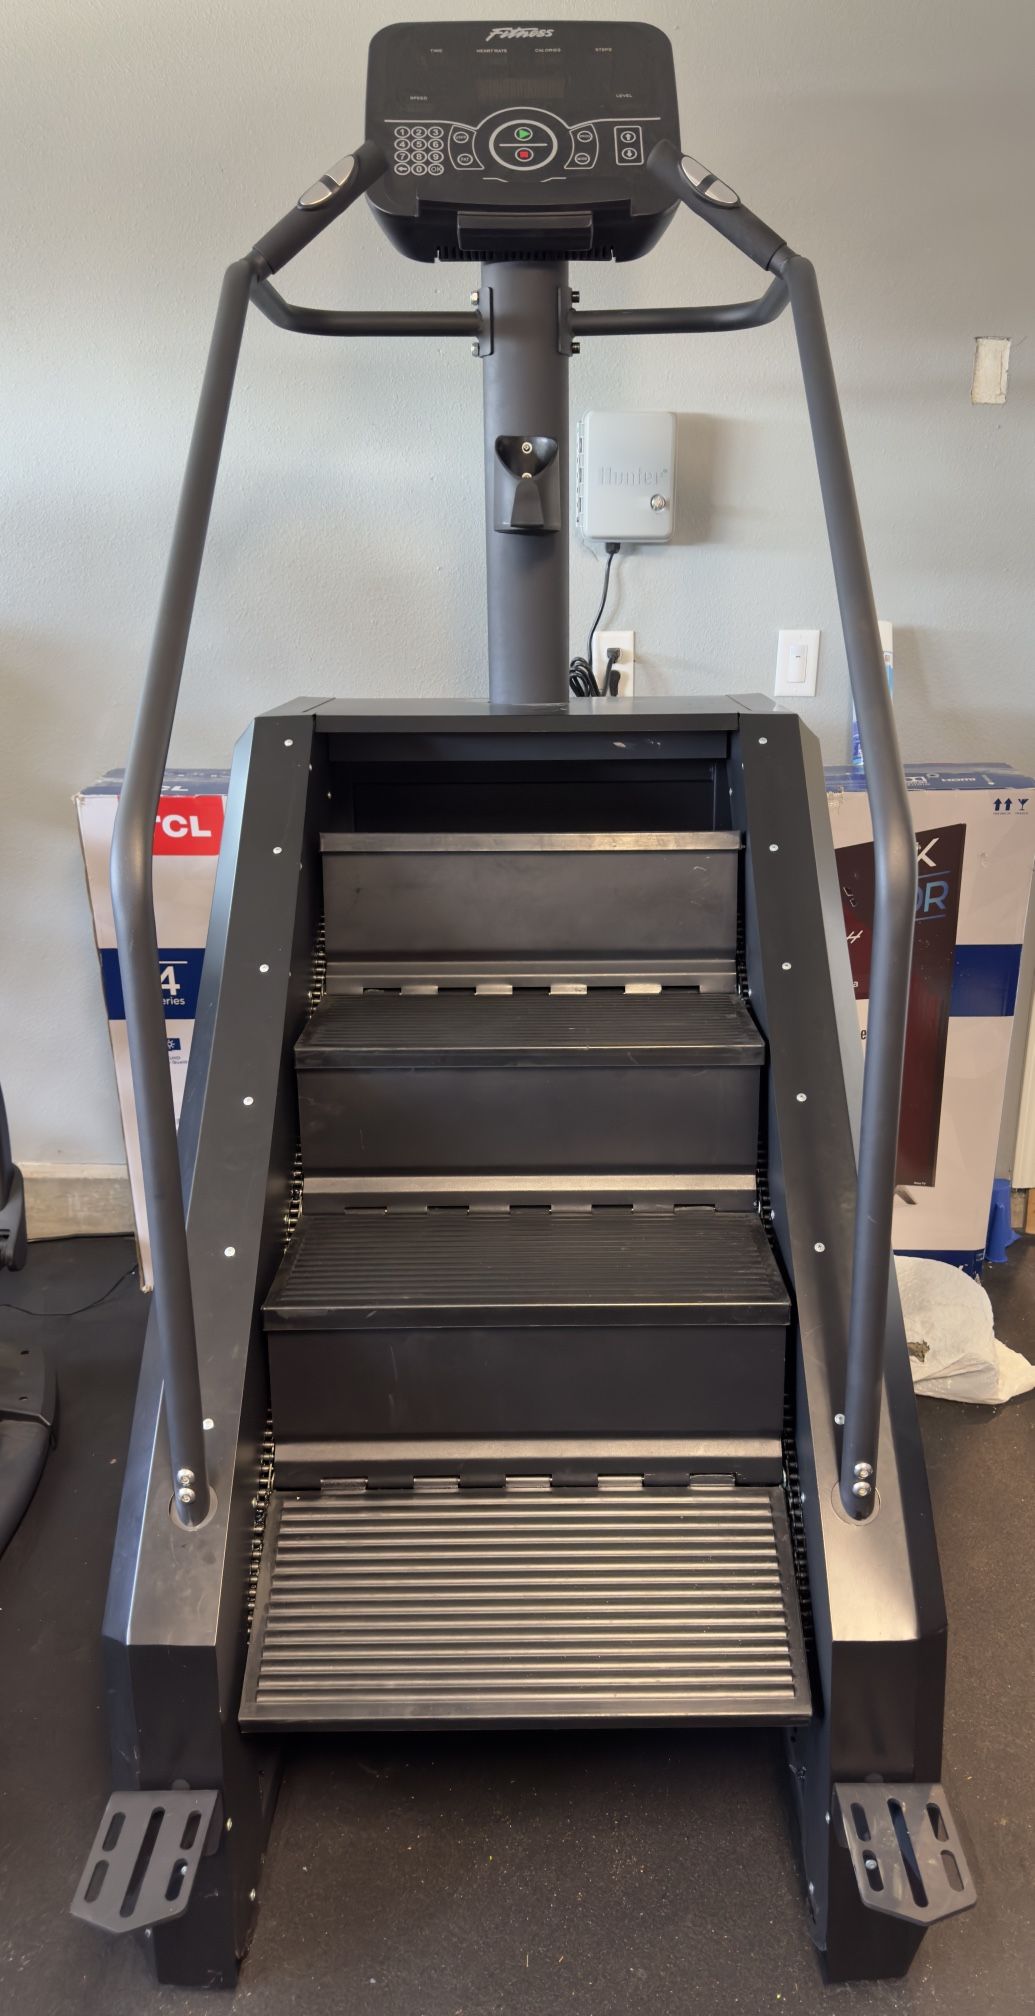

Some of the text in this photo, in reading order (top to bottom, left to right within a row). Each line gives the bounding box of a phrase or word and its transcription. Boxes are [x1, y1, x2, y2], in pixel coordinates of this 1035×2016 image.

[485, 27, 555, 41] Fitness
[600, 466, 661, 485] Hunter
[160, 965, 181, 996] 4
[163, 996, 186, 1005] eries
